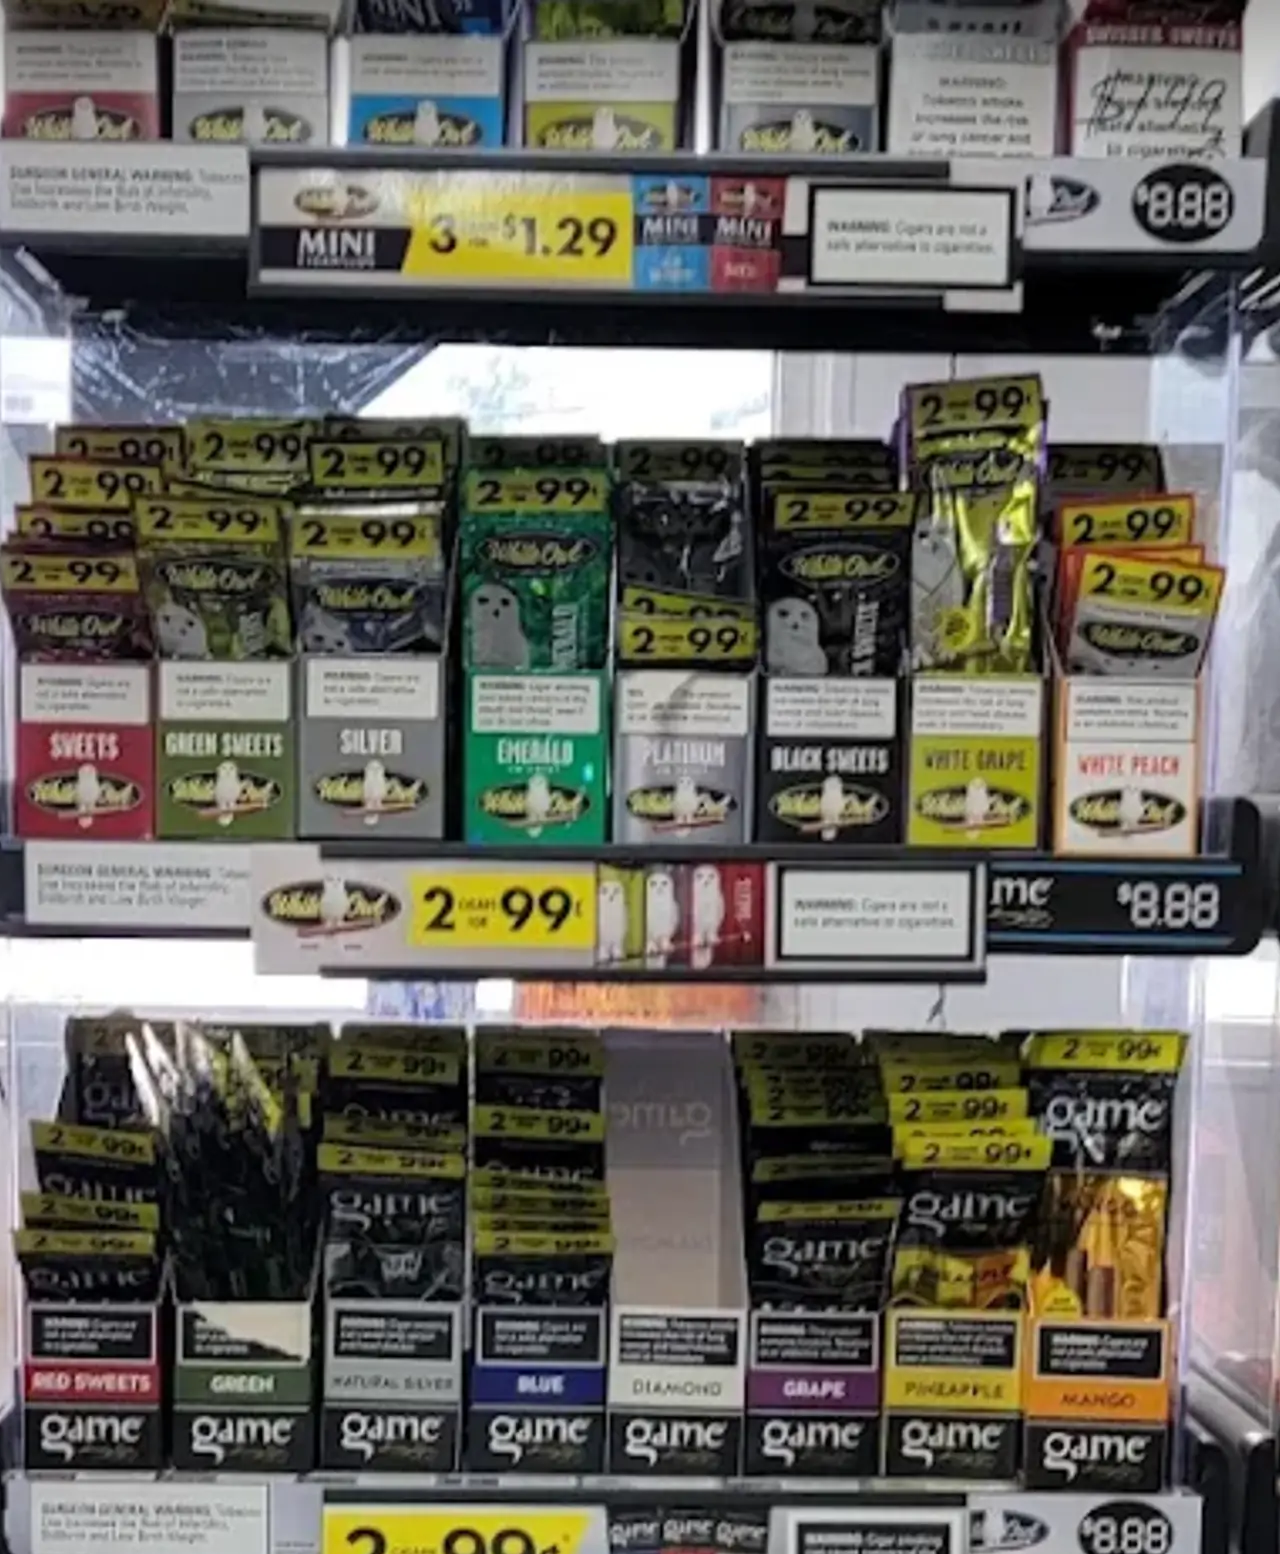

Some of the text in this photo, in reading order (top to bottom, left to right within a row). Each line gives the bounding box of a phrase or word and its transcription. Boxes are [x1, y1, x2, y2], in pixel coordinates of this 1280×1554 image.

[297, 229, 376, 255] MINI
[427, 215, 617, 257] 3 $1.29
[50, 733, 120, 759] SWEETS
[166, 733, 283, 758] GREEN SWEETS
[341, 729, 402, 756] SILVER
[498, 737, 575, 765] EMERALD
[643, 743, 726, 765] PLATINUM
[772, 746, 888, 772] BLACK SWEETS
[925, 749, 1027, 771] WHITE GRAPE
[1077, 754, 1179, 777] WHITE PEACH
[423, 890, 456, 932] 2
[1045, 1095, 1168, 1146] game
[32, 1372, 151, 1394] RED SWEETS
[211, 1374, 274, 1394] GREEN
[333, 1376, 453, 1392] NATURAL SILVER
[518, 1374, 563, 1395] BLUE
[632, 1379, 721, 1398] DIAMOND
[784, 1379, 846, 1400] GRAPE
[905, 1379, 1004, 1400] PINEAPPLE
[1060, 1390, 1135, 1410] MANGO
[41, 1414, 144, 1462] game
[489, 1412, 593, 1464] game
[762, 1418, 862, 1466] game
